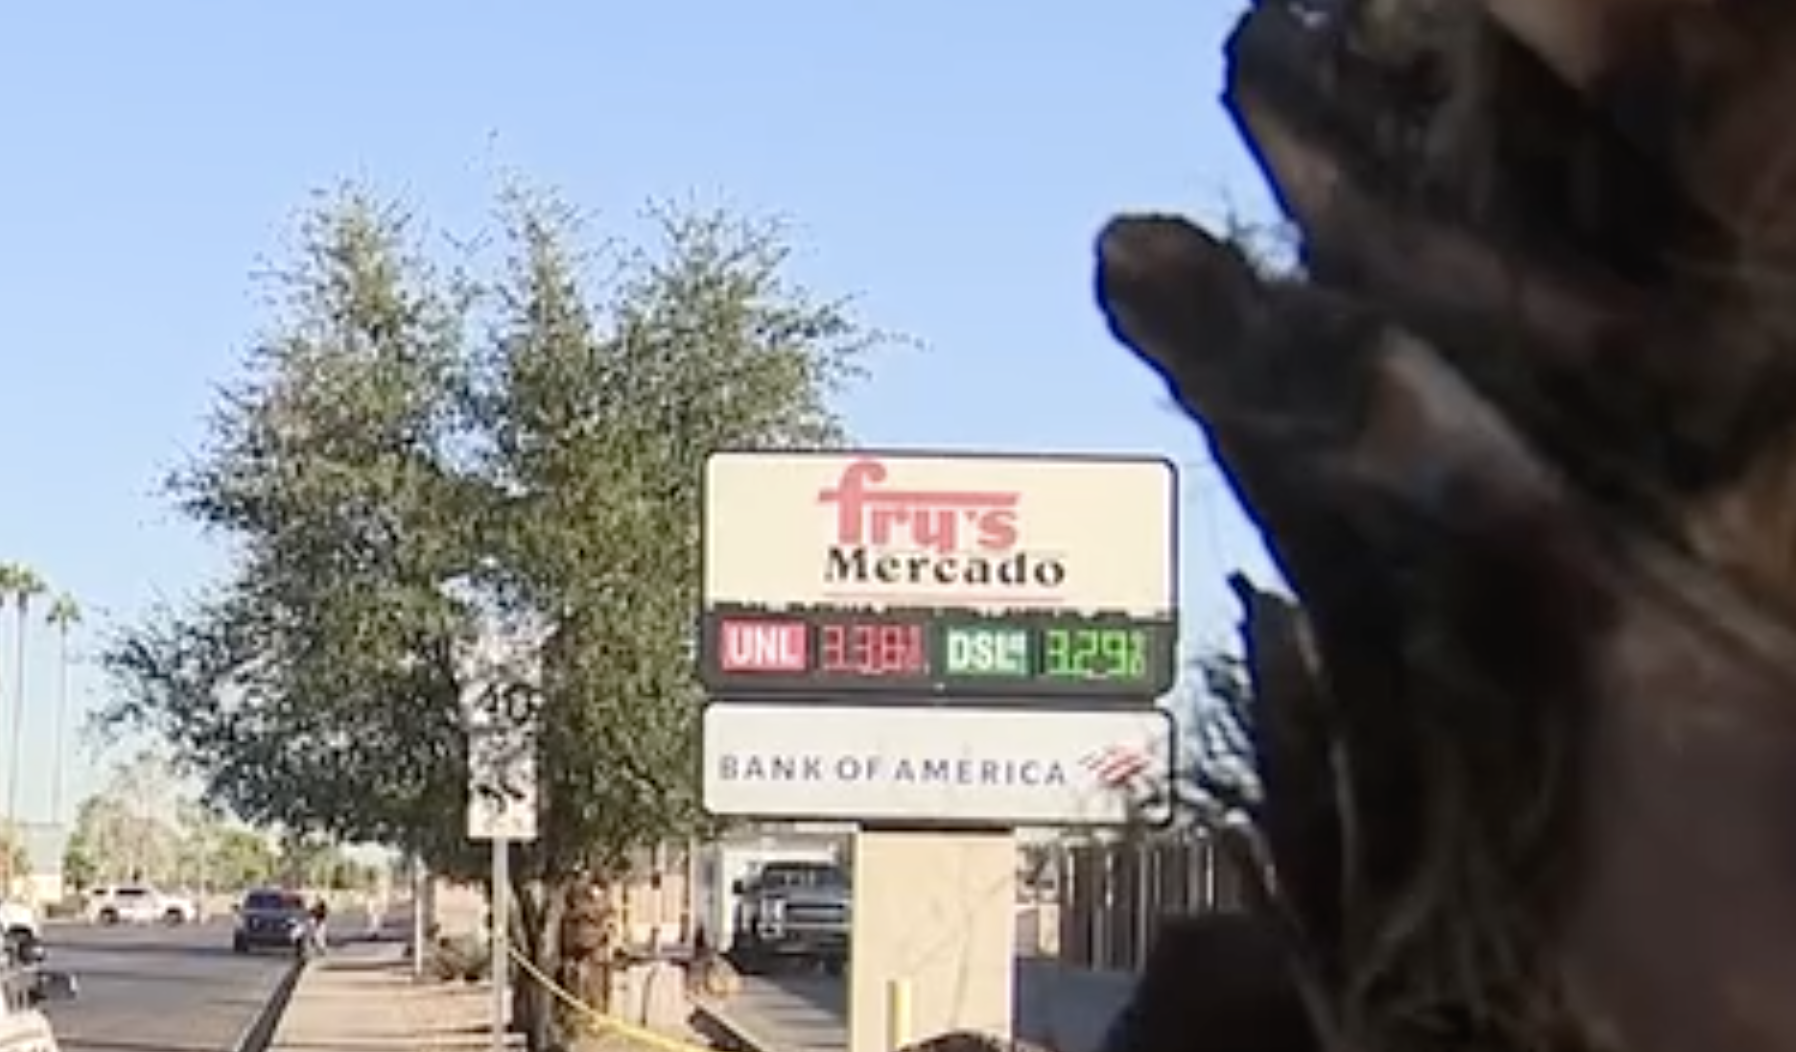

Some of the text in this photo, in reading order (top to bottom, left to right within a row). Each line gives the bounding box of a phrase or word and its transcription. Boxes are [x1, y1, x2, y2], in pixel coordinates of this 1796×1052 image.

[818, 461, 1019, 553] fry's
[824, 546, 1065, 587] Mercado
[729, 624, 801, 664] UNL
[475, 682, 534, 725] 40
[719, 754, 1067, 785] BANK OF AMERICA
